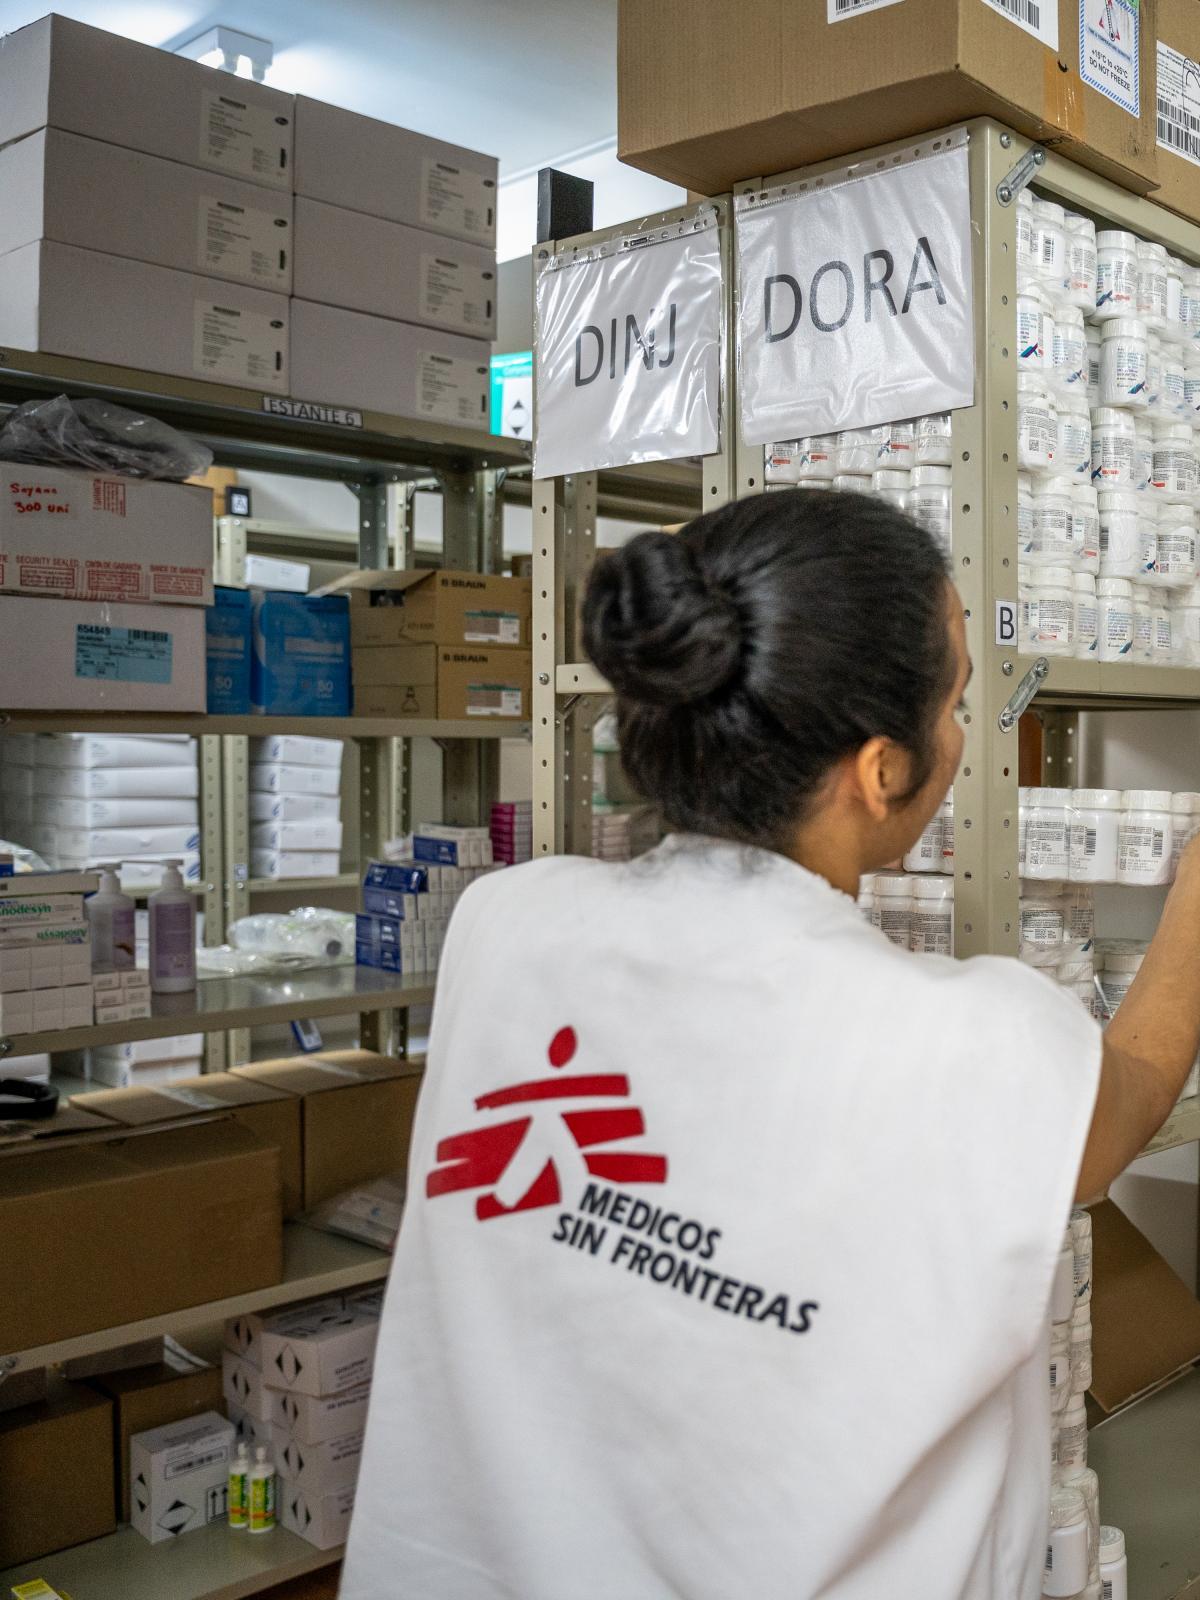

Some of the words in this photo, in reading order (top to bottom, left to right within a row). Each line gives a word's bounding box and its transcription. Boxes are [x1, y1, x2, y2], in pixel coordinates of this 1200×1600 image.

[1089, 56, 1097, 68] DO
[1099, 63, 1109, 76] NOT
[1110, 71, 1130, 91] FREEZE
[764, 236, 947, 344] DORA
[575, 303, 677, 387] DINJ
[270, 399, 341, 424] ESTANTE
[345, 412, 355, 426] 6
[14, 502, 41, 513] 300
[48, 503, 69, 513] uni
[16, 555, 51, 565] SECURITY
[52, 558, 79, 568] SEALED
[451, 579, 486, 590] BRAUN
[1000, 606, 1015, 640] B
[453, 654, 488, 664] BRAUN
[0, 902, 52, 916] nodesyn
[578, 1182, 722, 1260] MEDICOS
[552, 1213, 607, 1255] SIN
[610, 1235, 819, 1334] FRONTERAS
